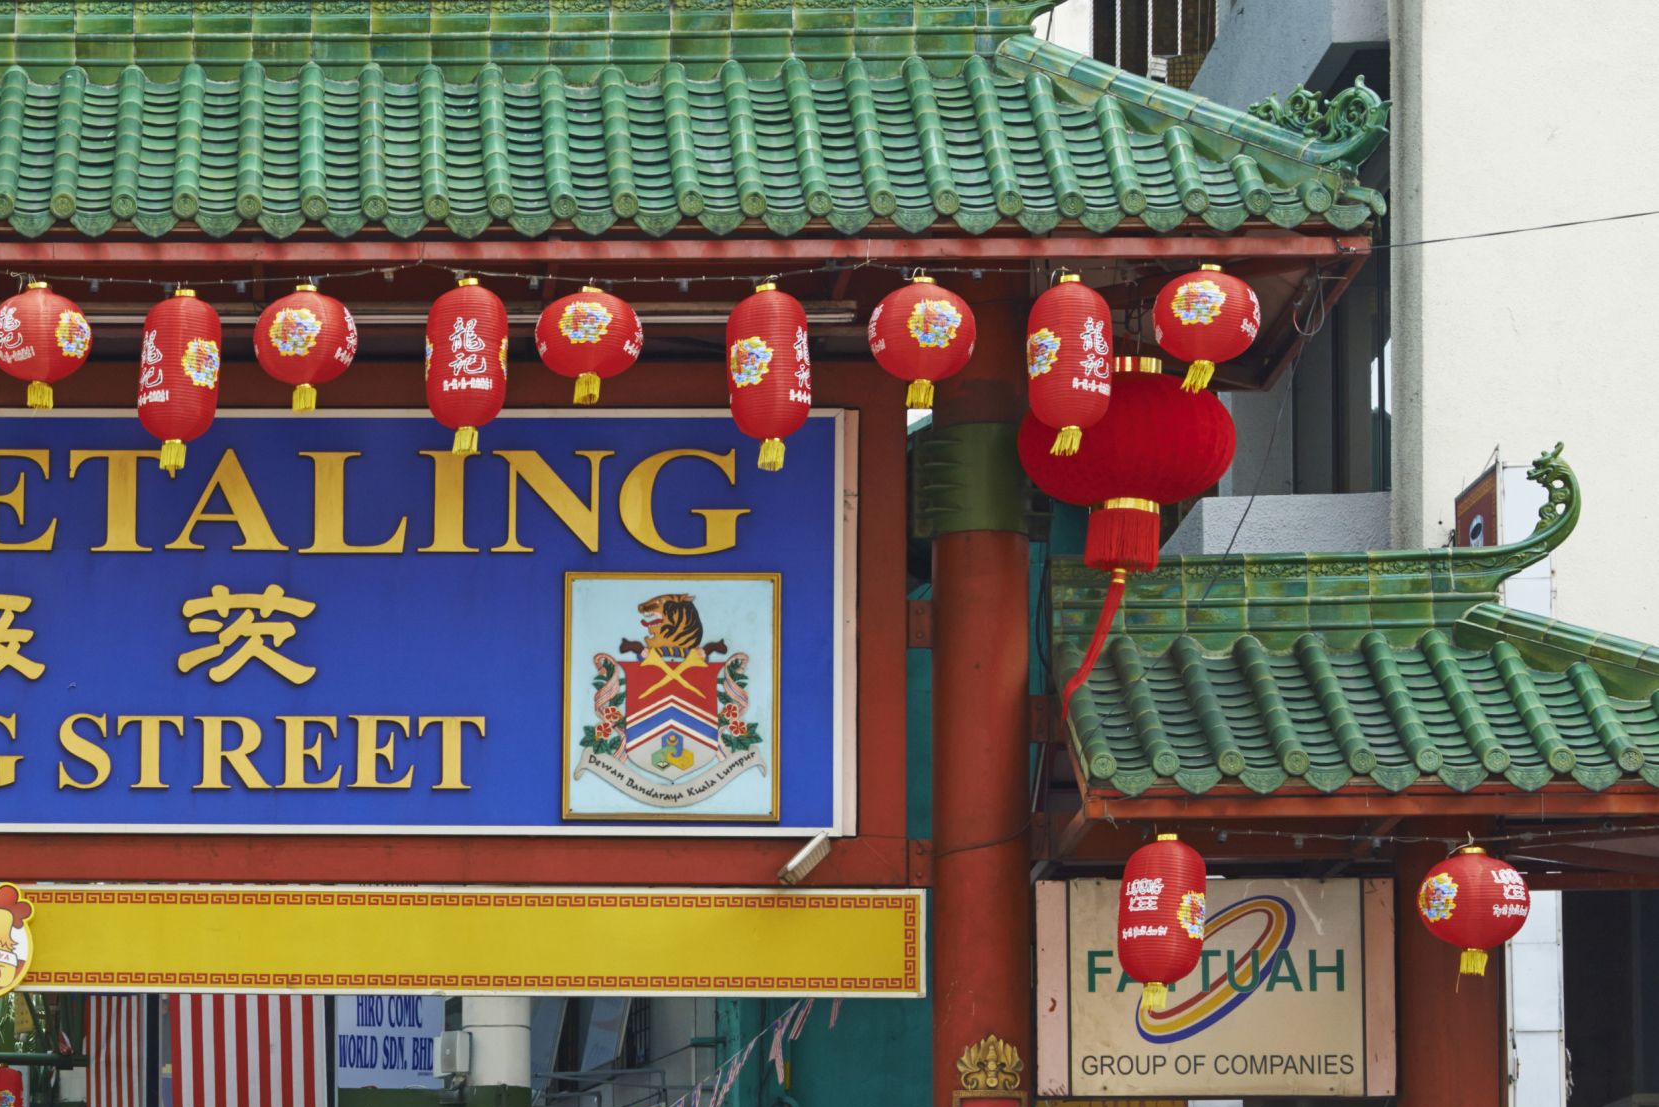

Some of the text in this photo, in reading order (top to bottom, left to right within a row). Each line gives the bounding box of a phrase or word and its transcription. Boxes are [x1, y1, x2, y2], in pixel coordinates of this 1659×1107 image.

[58, 712, 486, 790] STREET
[588, 751, 756, 802] Dewan Bandaraya Kuala Lumpur
[1087, 949, 1345, 993] FTUAH
[357, 995, 422, 1028] HIRO COMIC
[339, 1035, 377, 1069] WORLD
[1081, 1054, 1354, 1076] GROUP OF COMPANIES
